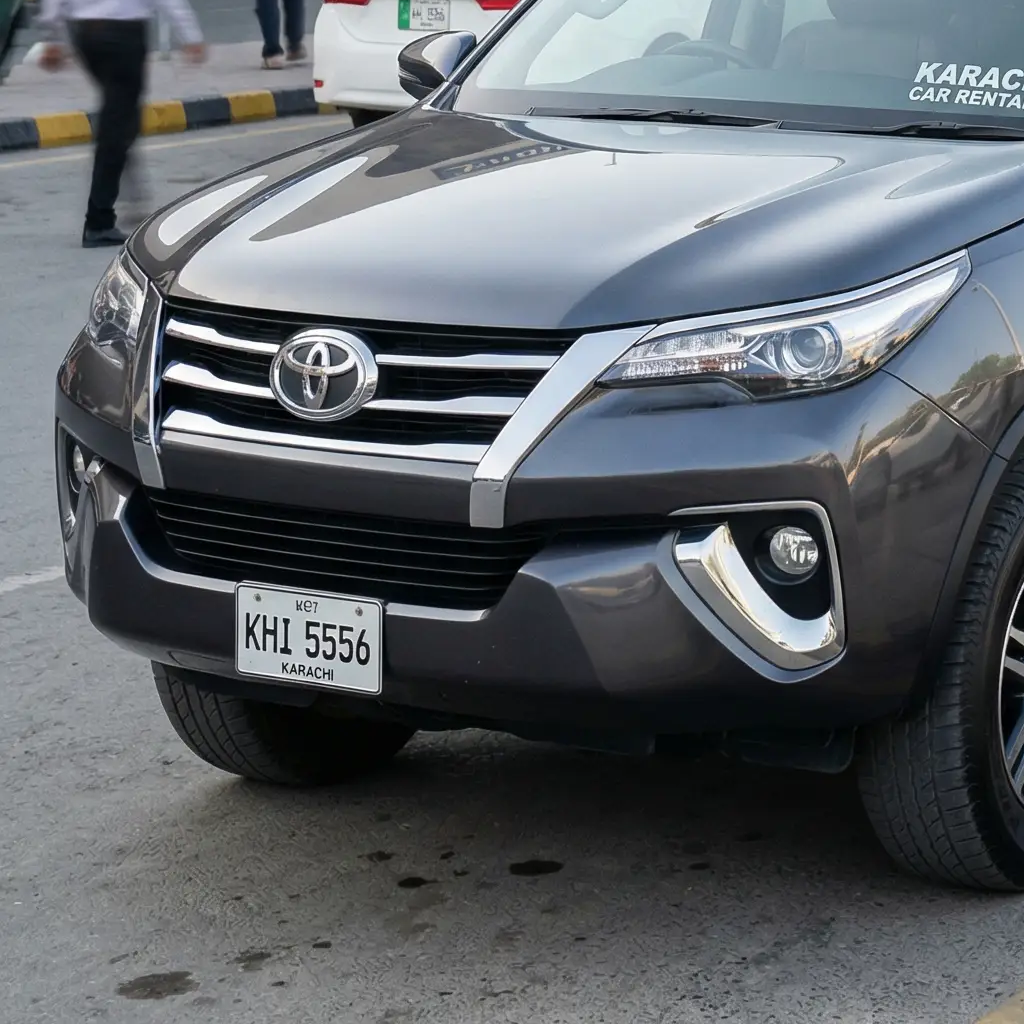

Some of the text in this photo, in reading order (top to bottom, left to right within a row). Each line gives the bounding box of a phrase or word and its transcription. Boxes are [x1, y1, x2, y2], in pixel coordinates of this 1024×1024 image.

[908, 86, 952, 103] CAR
[245, 612, 371, 666] KHI 5556
[281, 662, 334, 681] KARACHI
